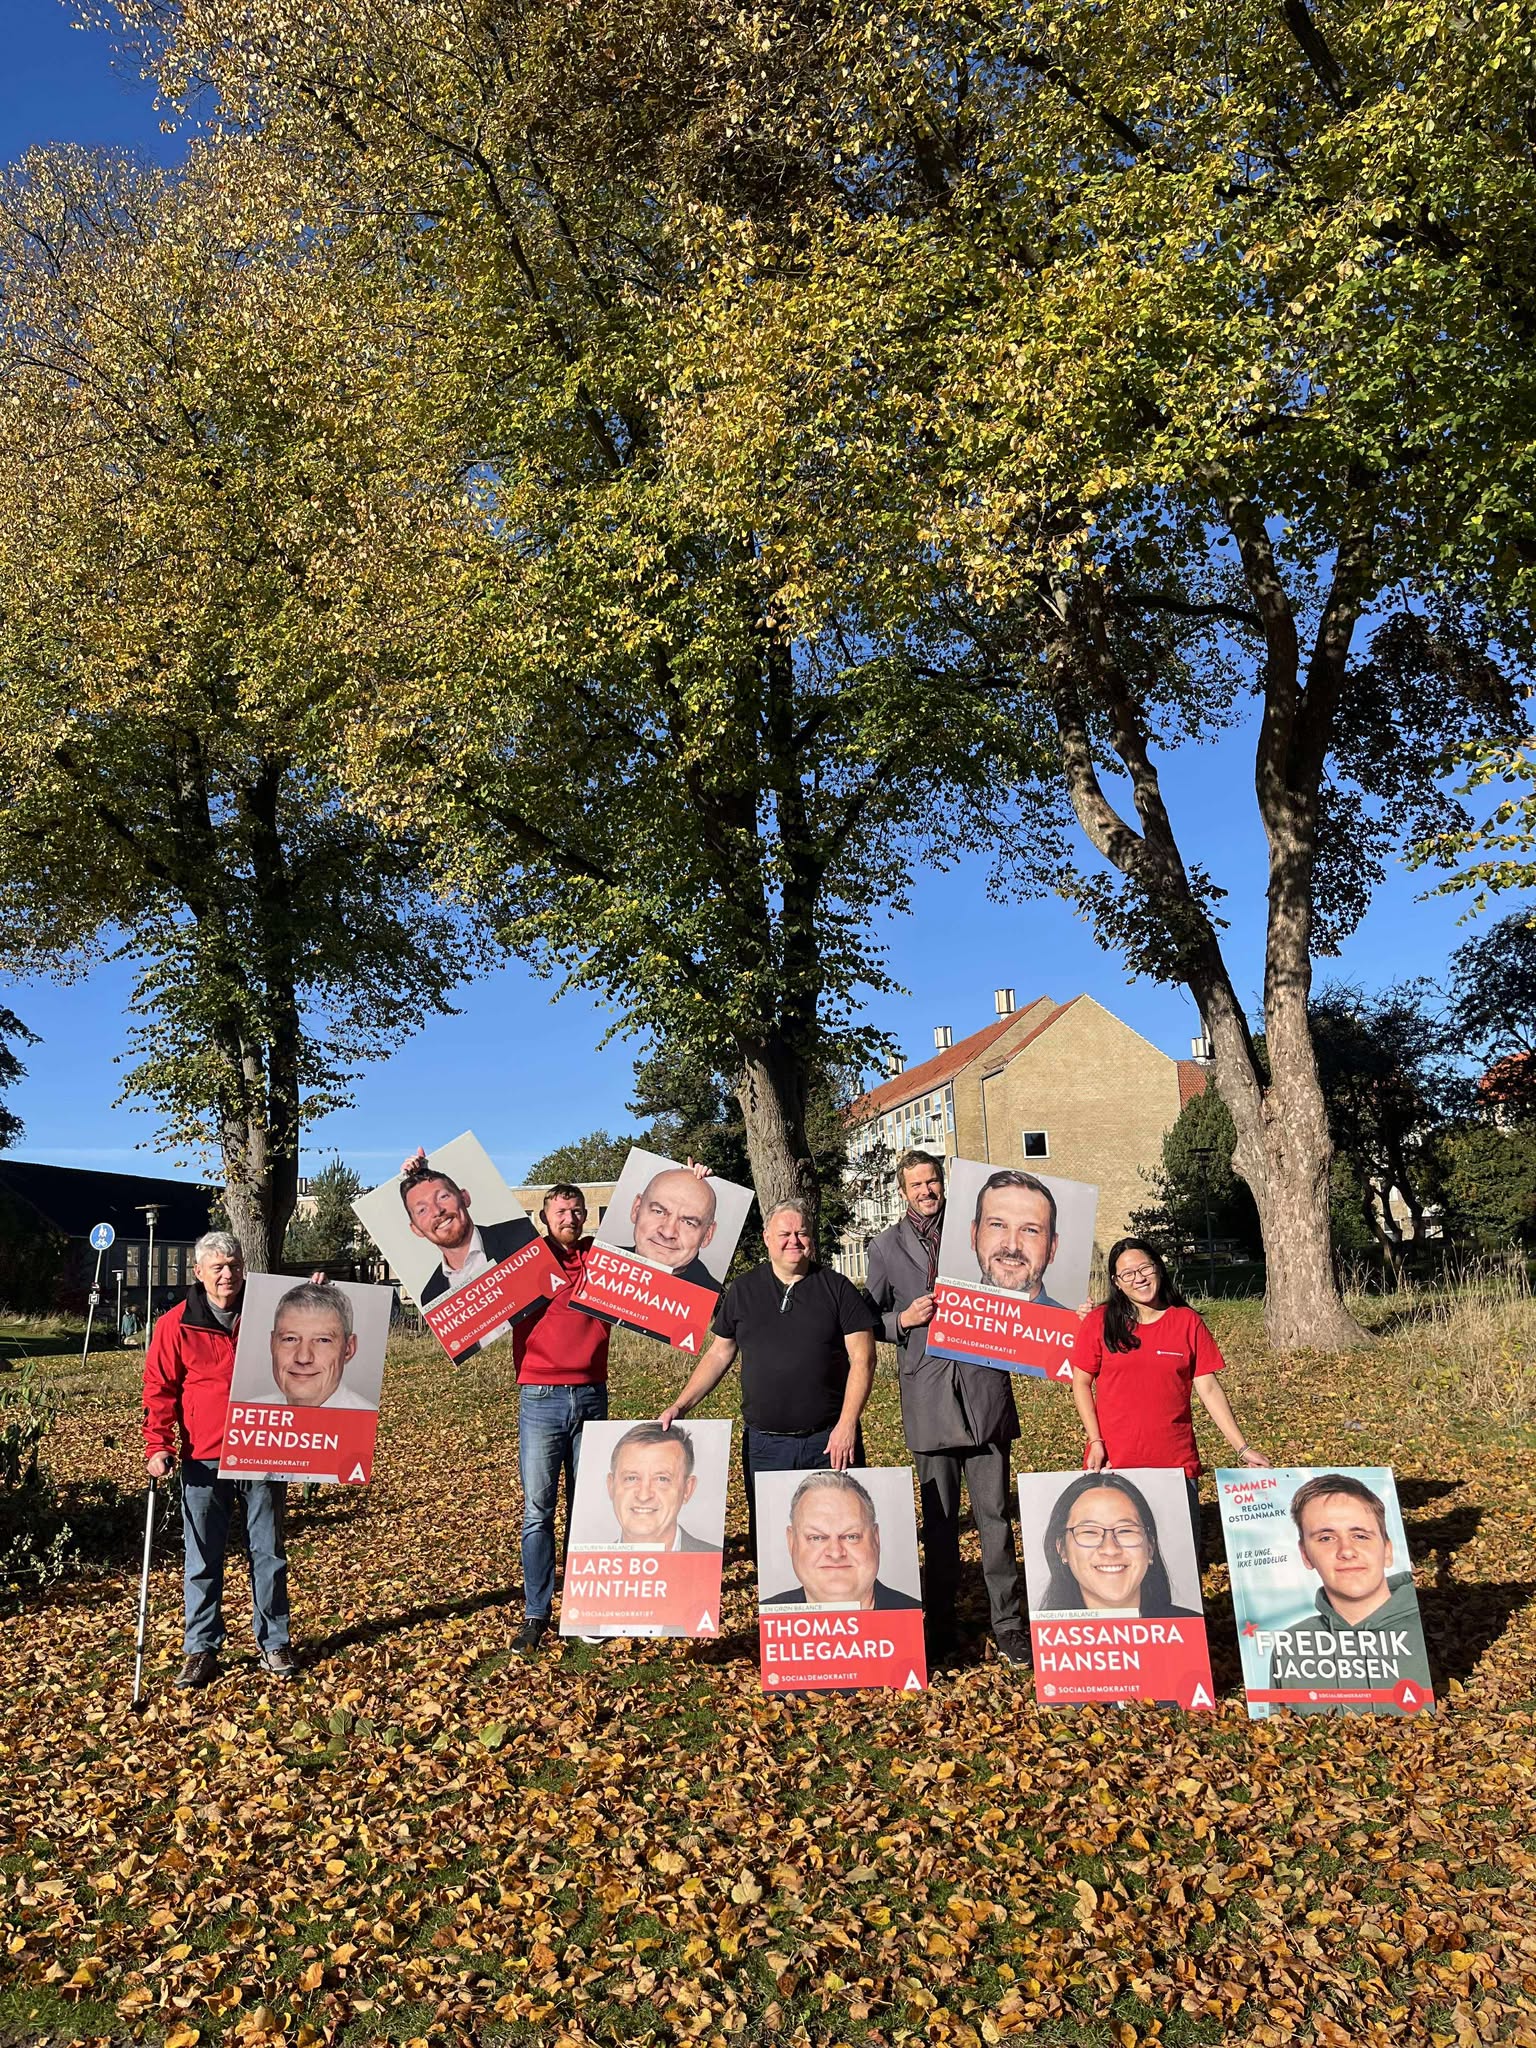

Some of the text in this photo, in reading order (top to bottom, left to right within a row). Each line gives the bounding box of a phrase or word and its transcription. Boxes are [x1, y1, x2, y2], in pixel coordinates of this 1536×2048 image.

[588, 1253, 652, 1286] JESPER
[430, 1245, 540, 1326] NIELS GYLDENLUND
[550, 1273, 566, 1292] A
[584, 1268, 690, 1320] KAMPMANN
[936, 1290, 1021, 1319] JOACHIM
[437, 1287, 504, 1338] MIKKELSEN
[588, 1295, 649, 1321] SOCIALDEMOKRATIET
[460, 1301, 517, 1343] SOCIALDEMOKRATIET
[935, 1308, 1075, 1348] HOLTEN PALVIG
[679, 1332, 695, 1351] A
[946, 1336, 1017, 1355] SOCIALDEMOKRATIET
[1056, 1358, 1074, 1379] A
[231, 1408, 294, 1427] PETER
[228, 1429, 338, 1450] SVENDSEN
[239, 1458, 310, 1467] SOCIALDEMOKRATIET
[348, 1462, 366, 1481] A
[1224, 1478, 1277, 1494] SAMMEN
[1234, 1494, 1254, 1504] OM
[1241, 1502, 1274, 1512] REGION
[1237, 1559, 1251, 1568] IKKE
[1244, 1550, 1252, 1558] ER
[571, 1558, 659, 1575] LARS BO
[569, 1580, 667, 1598] WINTHER
[696, 1609, 715, 1632] A
[764, 1617, 859, 1638] THOMAS
[1037, 1624, 1184, 1646] KASSANDRA
[1255, 1630, 1412, 1656] FREDERIK
[766, 1640, 895, 1662] ELLEGAARD
[1039, 1651, 1140, 1672] HANSEN
[781, 1673, 858, 1682] SOCIALDEMOKRATIET
[1272, 1658, 1400, 1679] JACOBSEN
[904, 1669, 922, 1690] A
[1058, 1685, 1140, 1694] SOCIALDEMOKRATIET
[1190, 1682, 1213, 1707] A
[1402, 1687, 1416, 1703] A
